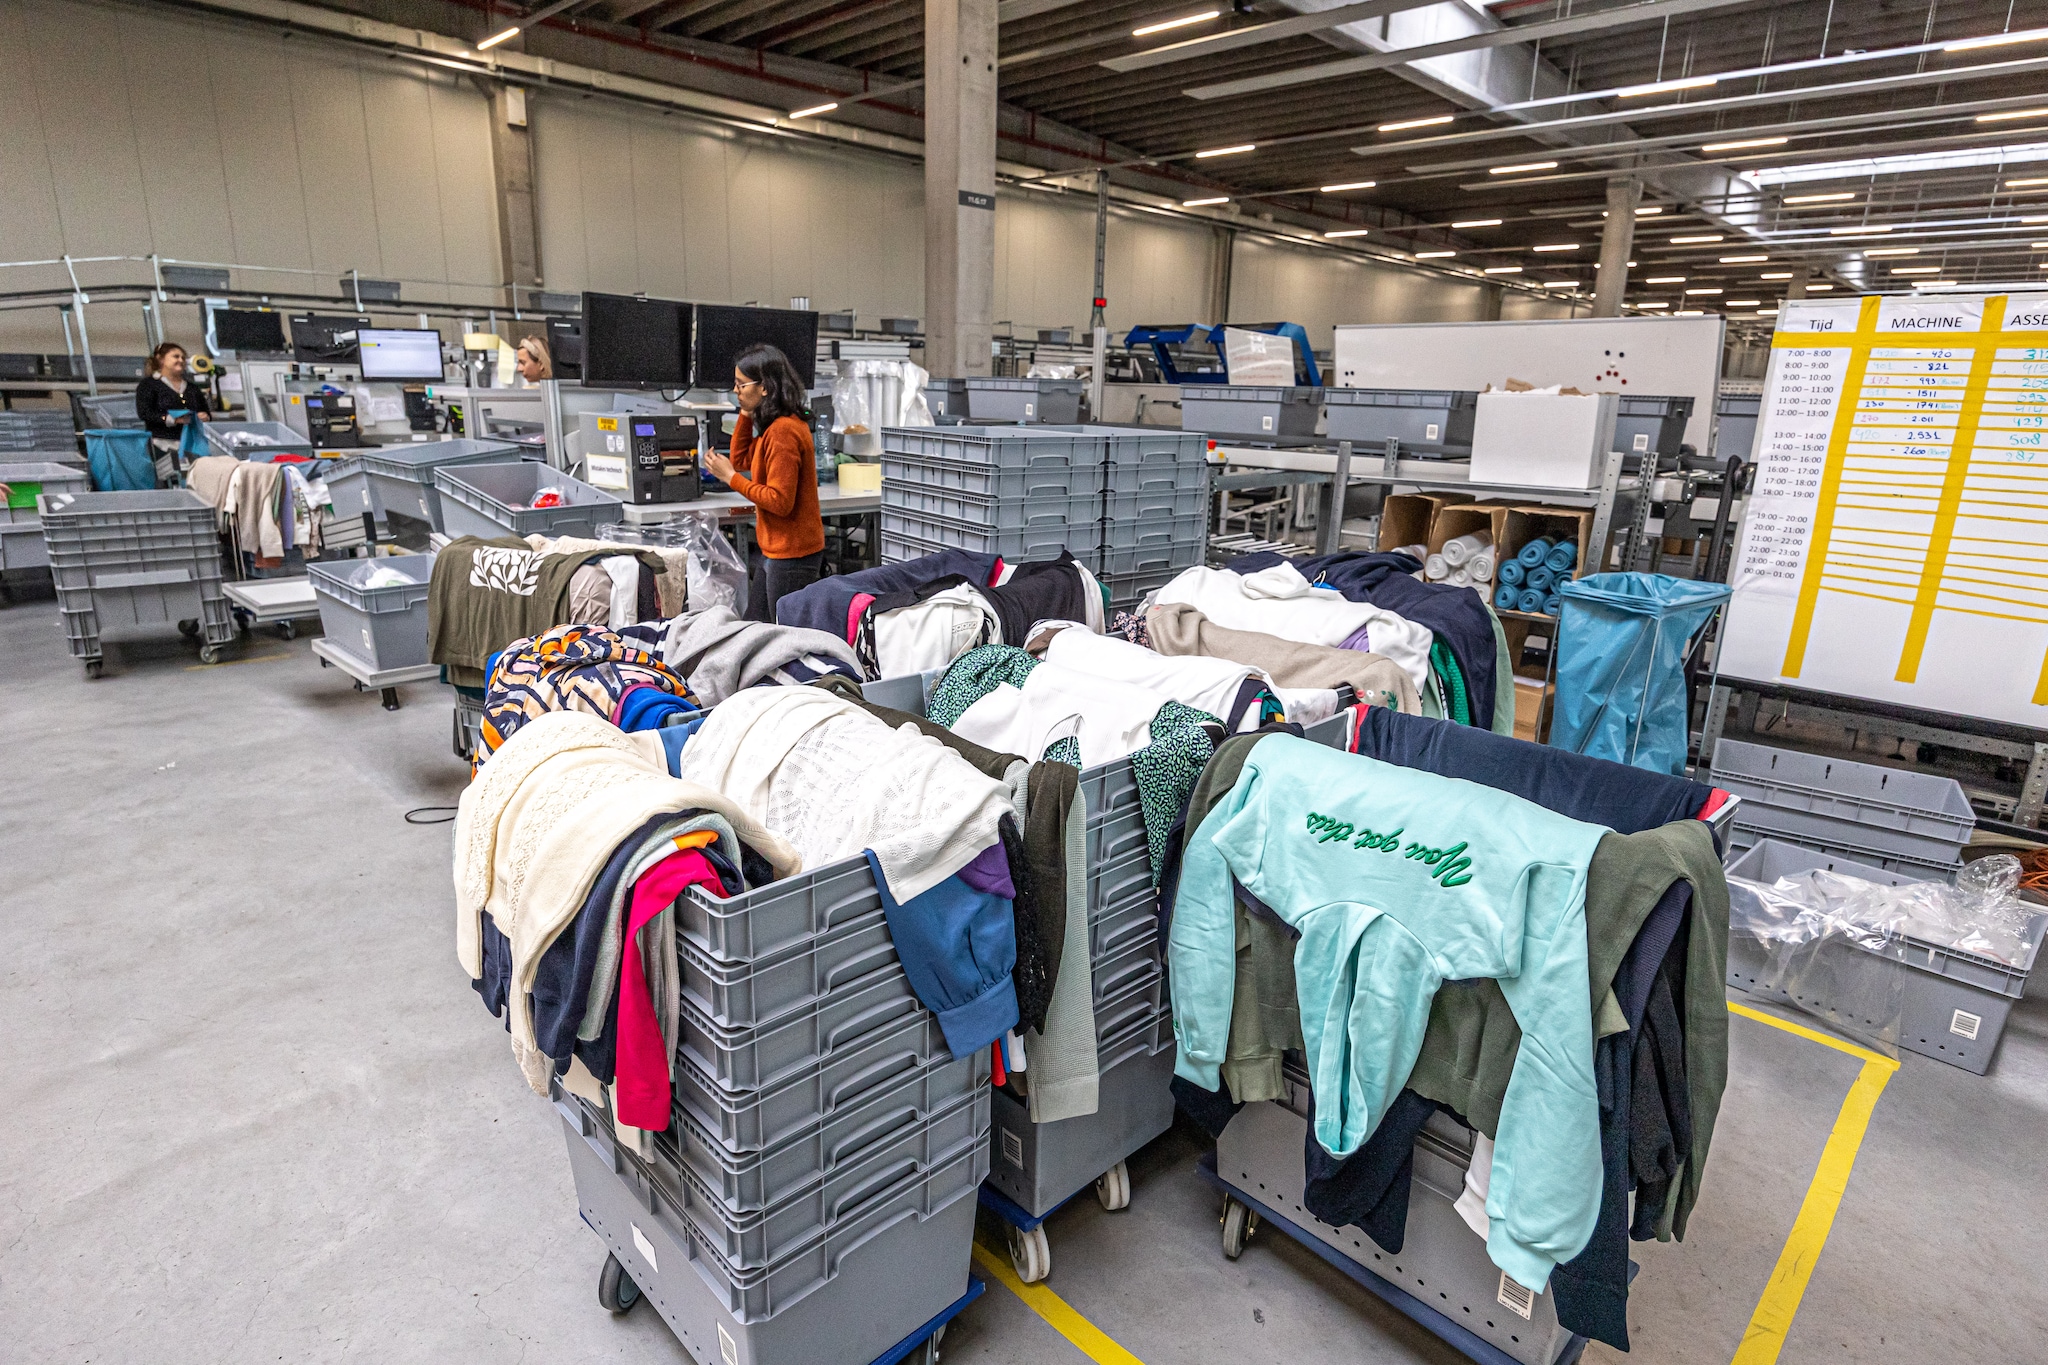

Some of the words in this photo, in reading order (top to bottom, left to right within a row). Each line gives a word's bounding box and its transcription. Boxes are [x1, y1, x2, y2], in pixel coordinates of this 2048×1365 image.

[1810, 319, 1833, 332] Tijd
[1891, 317, 1963, 329] MACHINE
[1932, 350, 1952, 358] 420
[2023, 349, 2048, 360] 31
[2009, 432, 2041, 445] 508
[1773, 571, 1795, 579] 01:00
[1306, 812, 1355, 843] this
[1354, 828, 1404, 853] got
[1405, 841, 1473, 888] You
